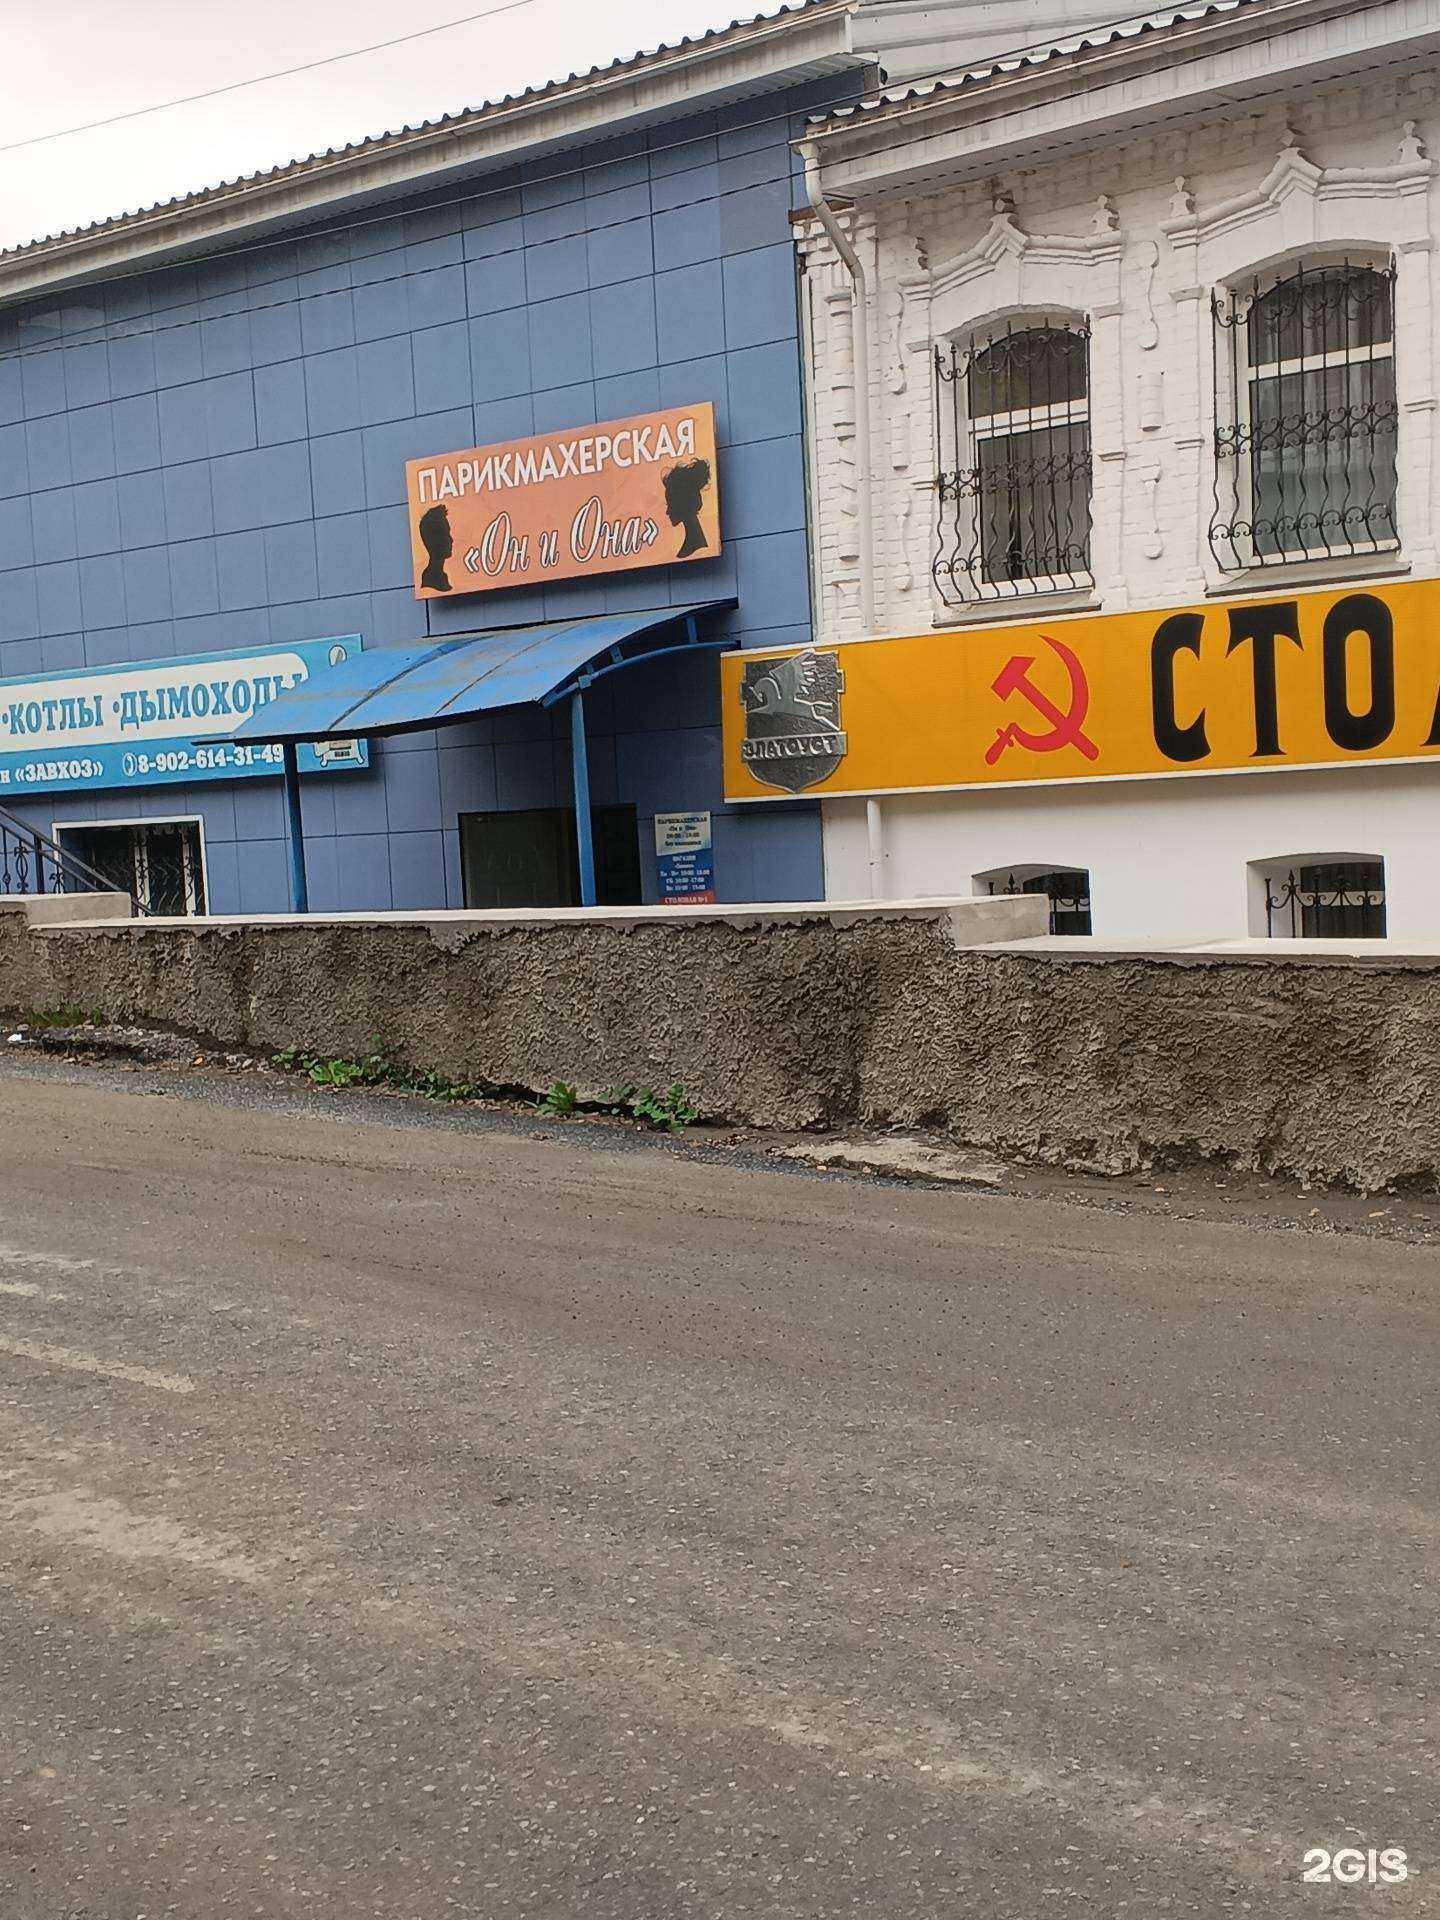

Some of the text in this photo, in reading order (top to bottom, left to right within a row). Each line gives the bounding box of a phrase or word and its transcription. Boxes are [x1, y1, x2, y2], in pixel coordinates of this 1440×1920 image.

[417, 418, 695, 502] ПАРИКМАХЕРСКАЯ
[463, 496, 659, 577] «Он и Она»
[1150, 593, 1440, 763] СТО
[15, 759, 104, 782] «ЗАВХОЗ»
[137, 744, 284, 773] 8-902-614-31-49
[743, 735, 834, 759] ЗЛАТОУСТ
